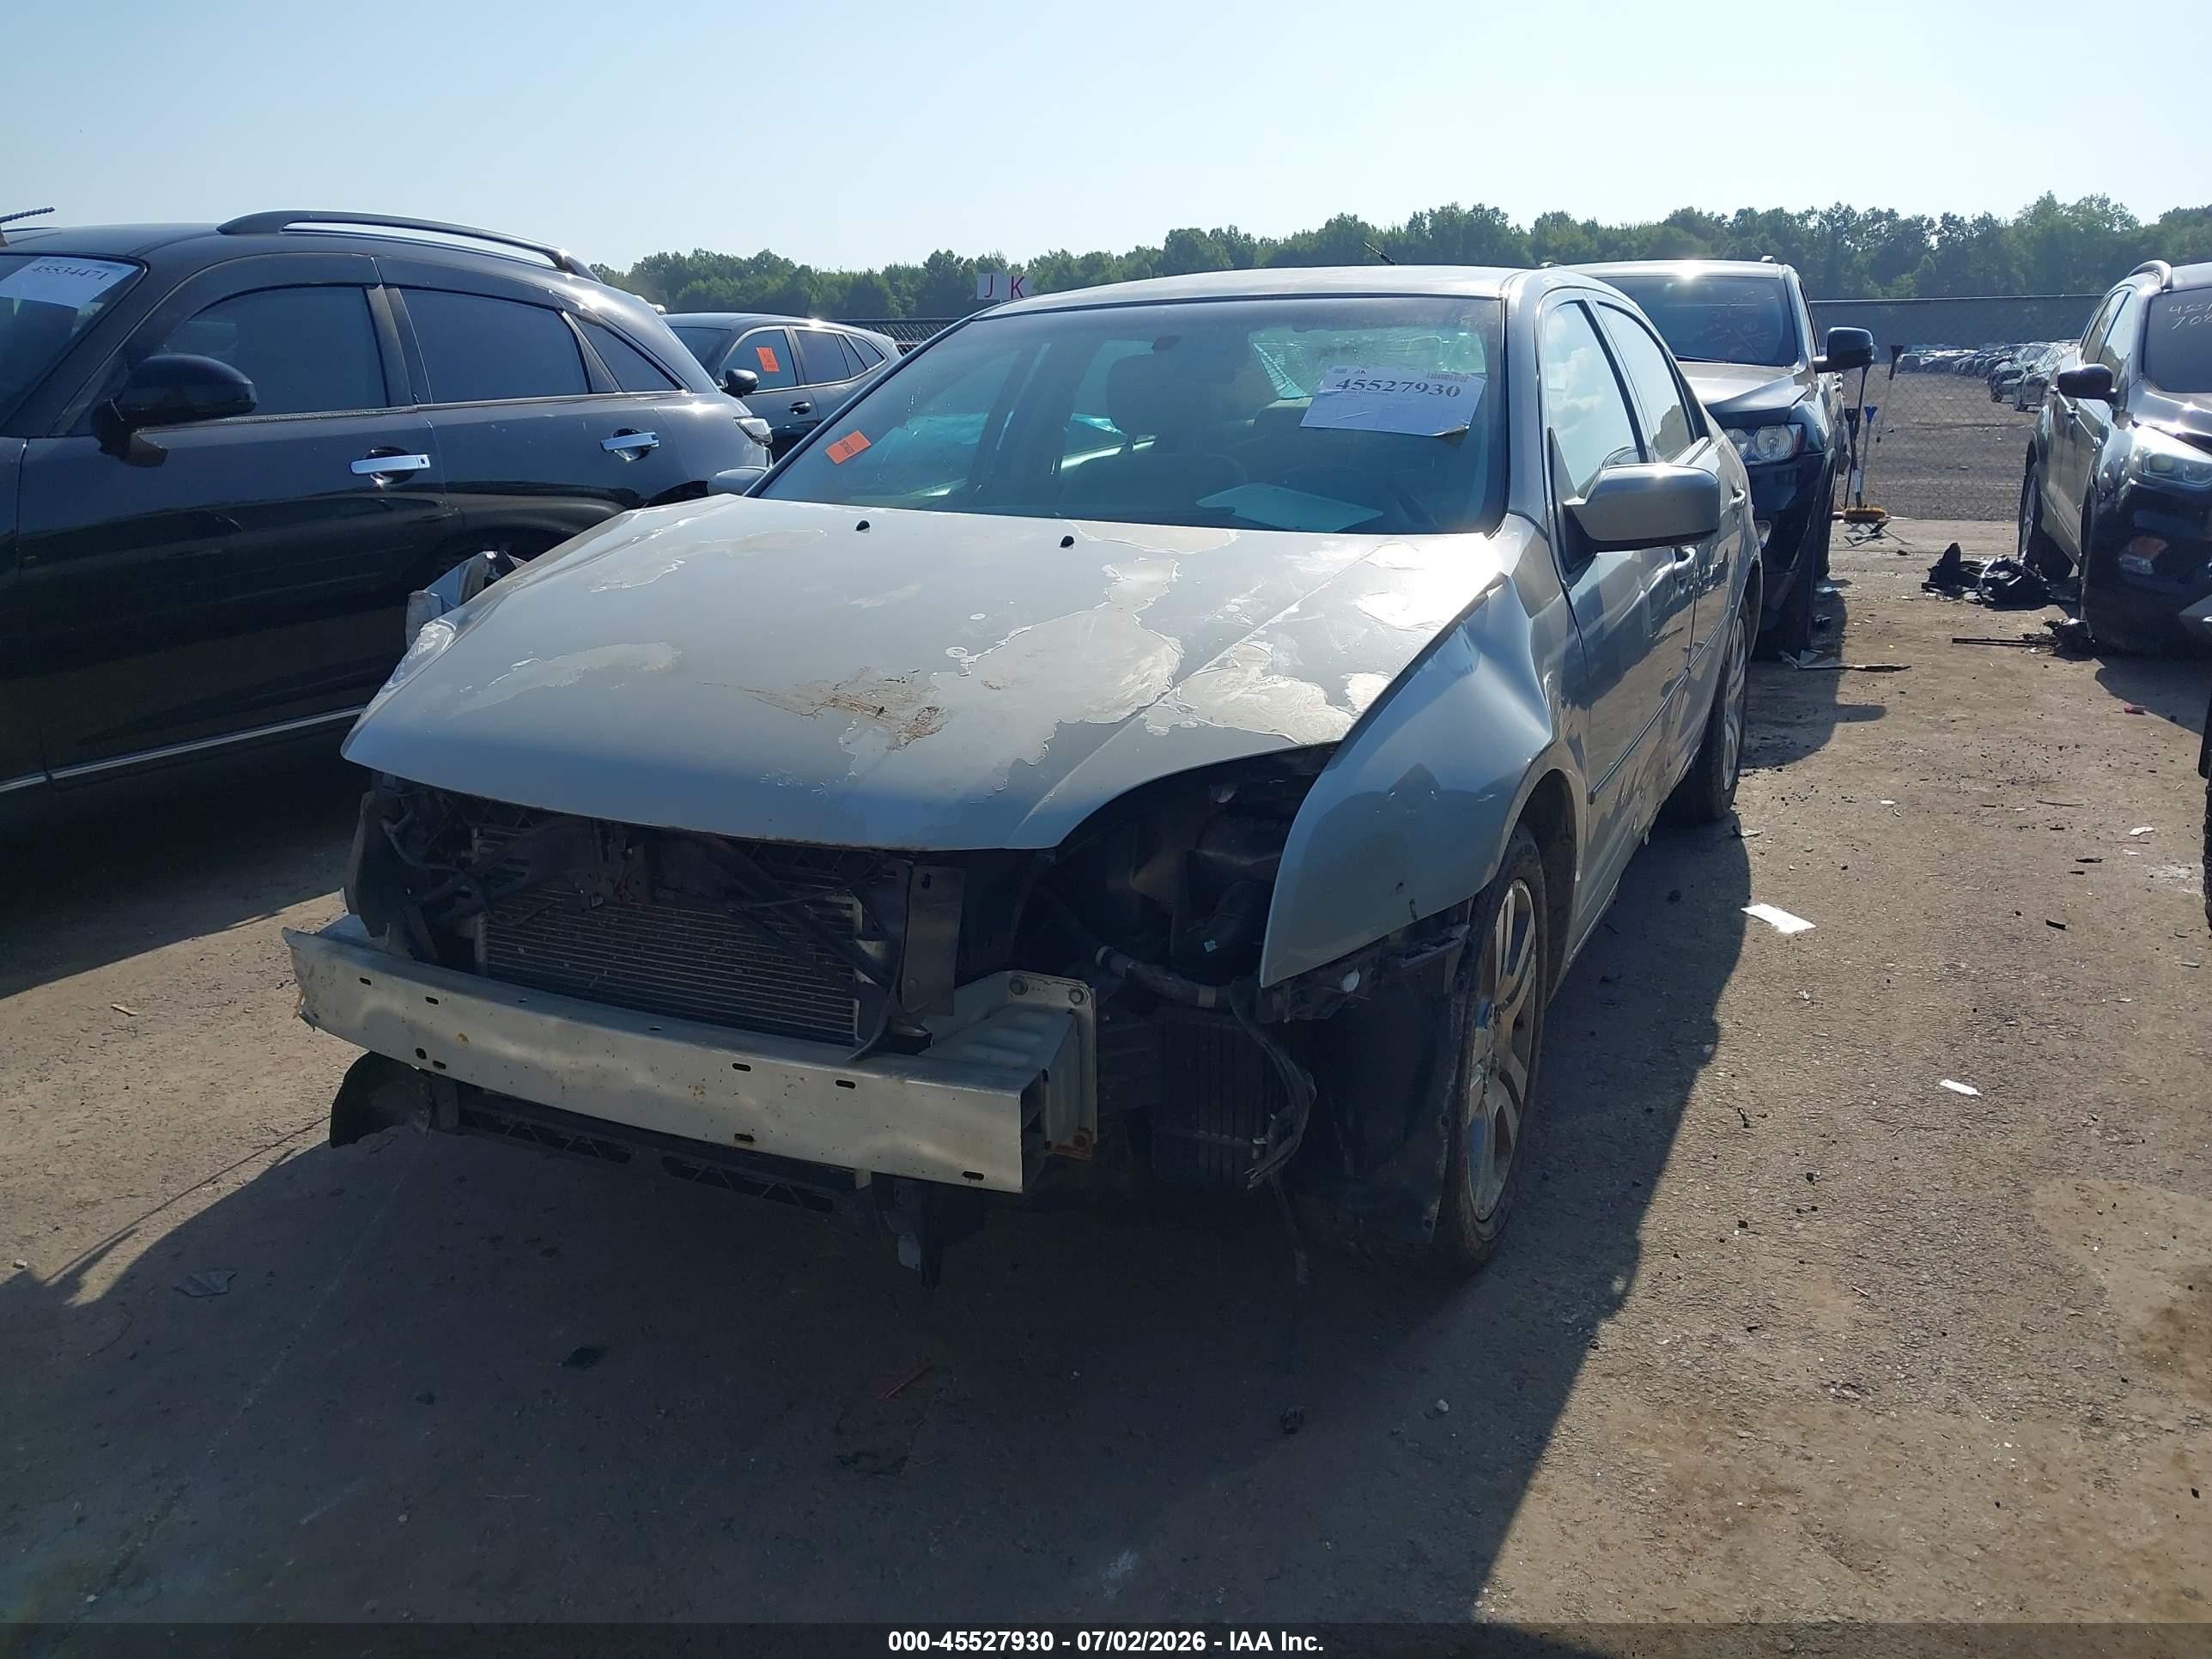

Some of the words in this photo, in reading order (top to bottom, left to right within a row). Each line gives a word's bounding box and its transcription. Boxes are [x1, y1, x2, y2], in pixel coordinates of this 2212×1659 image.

[31, 265, 111, 281] 45534471
[984, 274, 994, 298] J
[1011, 276, 1025, 299] K
[1334, 378, 1462, 398] 45527930
